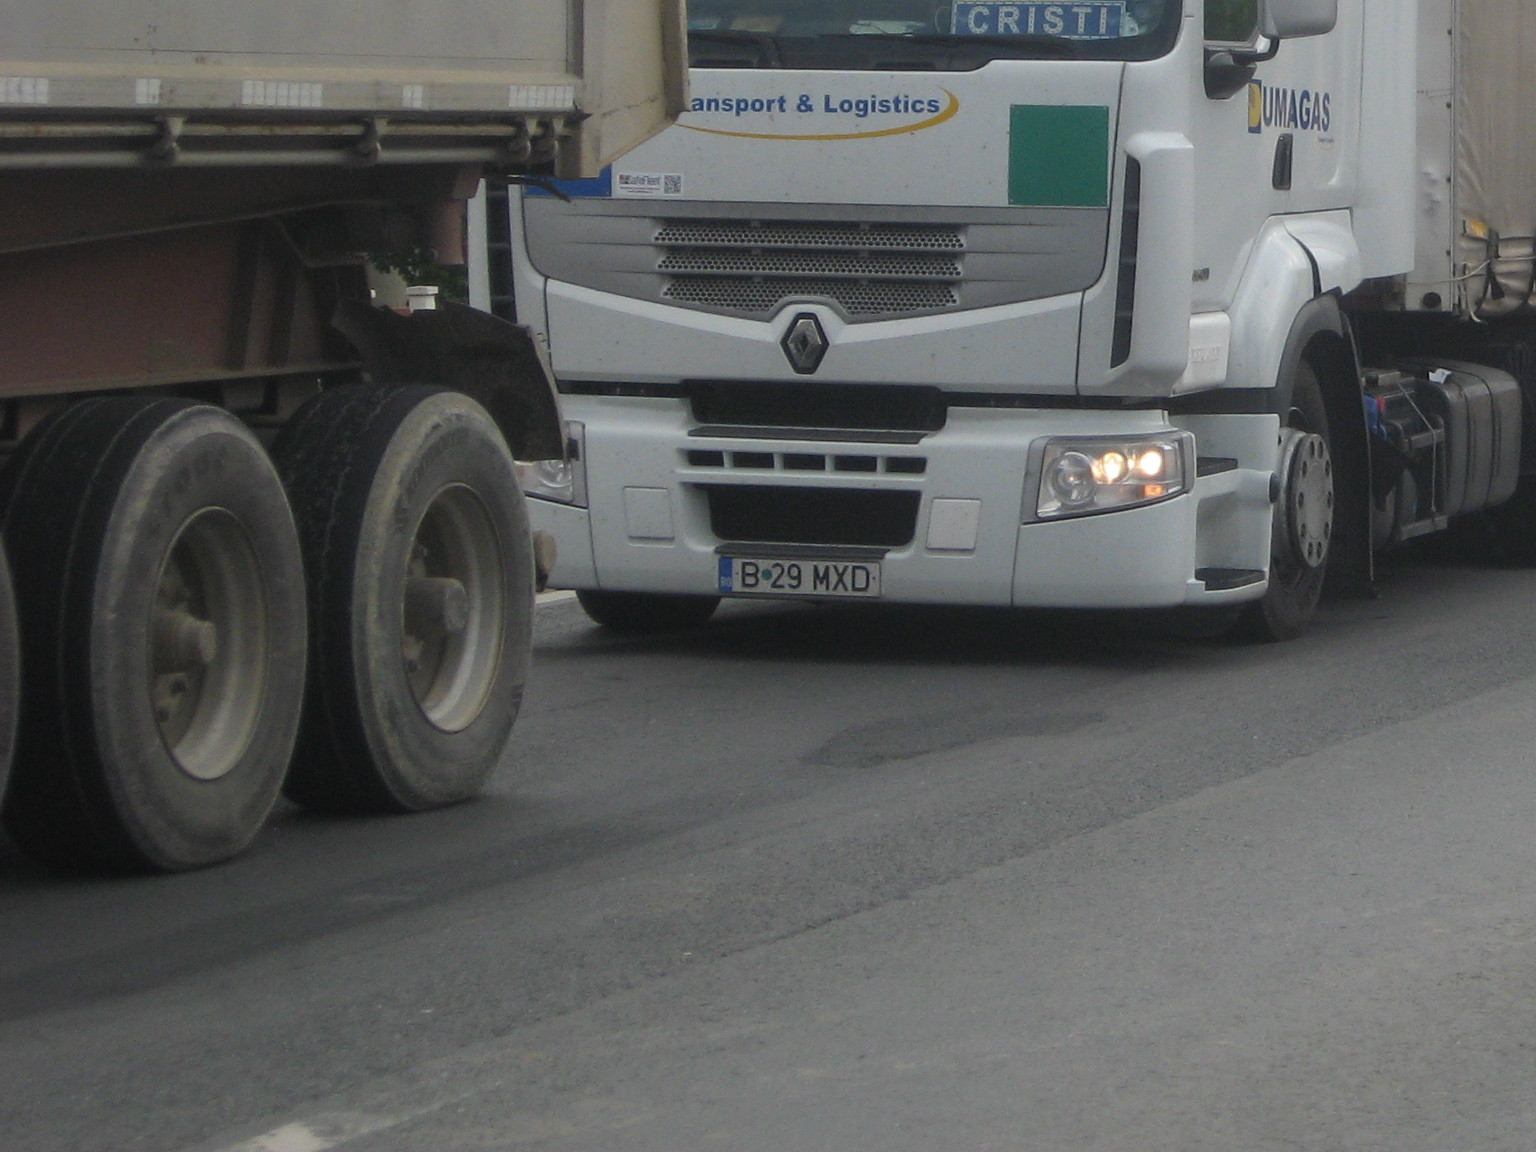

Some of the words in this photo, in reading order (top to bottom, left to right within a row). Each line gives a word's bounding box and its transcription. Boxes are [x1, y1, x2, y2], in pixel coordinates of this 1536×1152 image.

[967, 5, 1108, 35] CRISTI
[691, 95, 786, 116] ansport
[796, 94, 813, 113] &
[824, 94, 940, 117] Logistics
[813, 564, 870, 592] MXD
